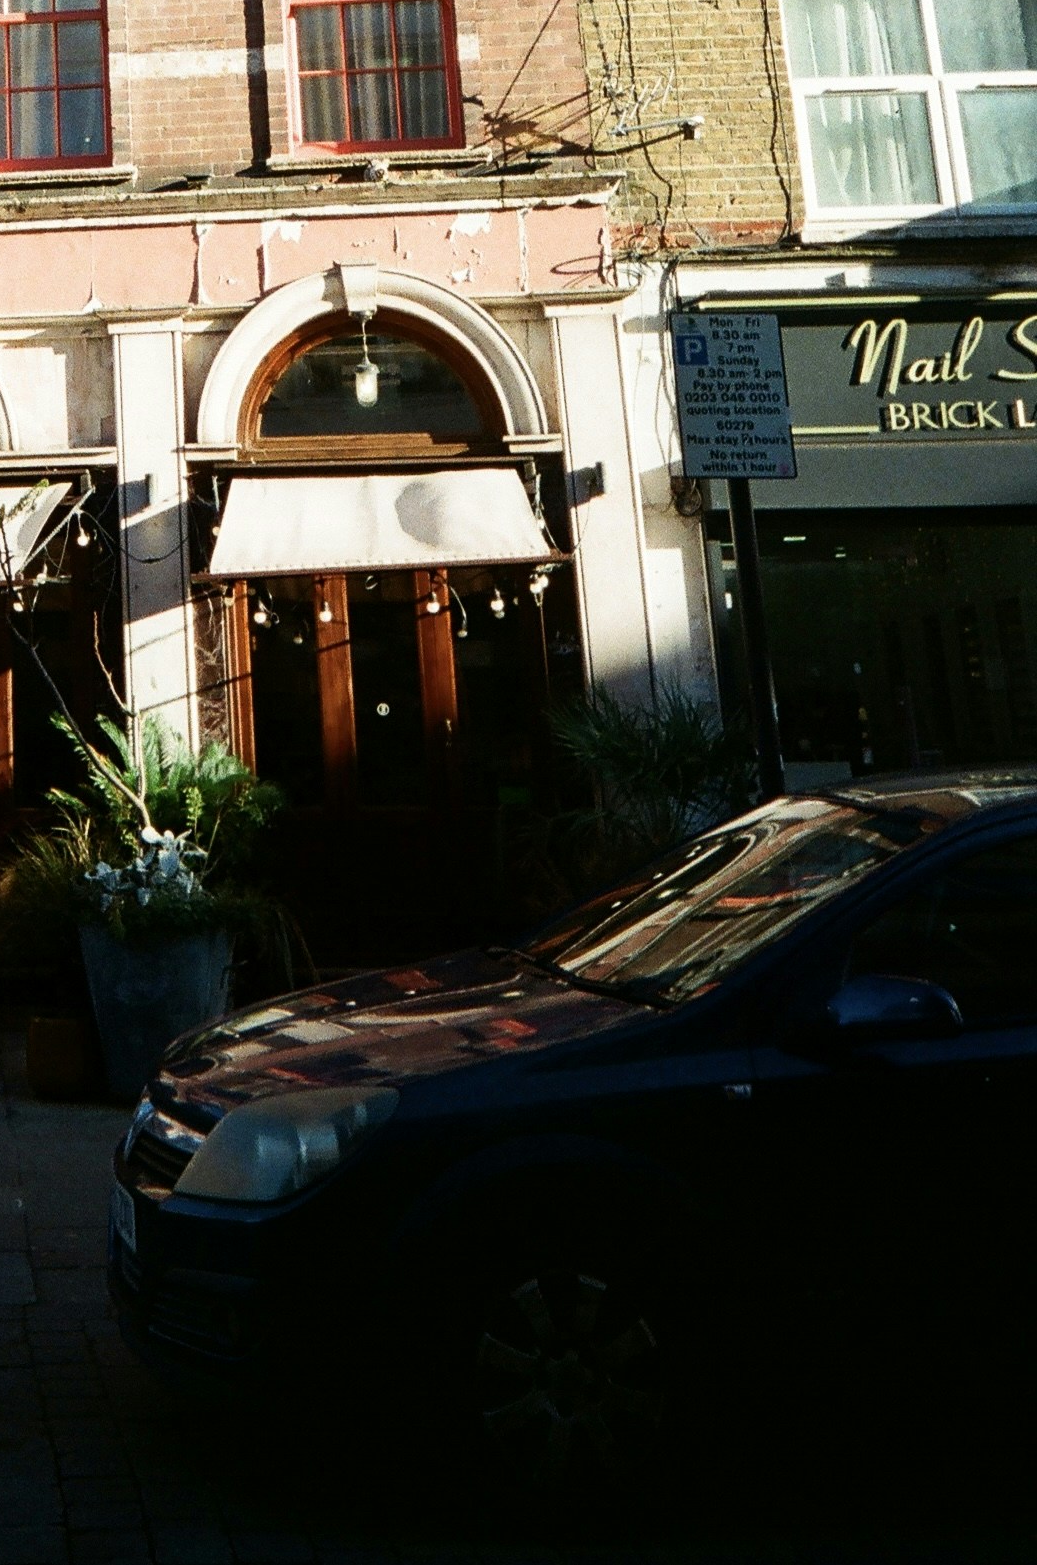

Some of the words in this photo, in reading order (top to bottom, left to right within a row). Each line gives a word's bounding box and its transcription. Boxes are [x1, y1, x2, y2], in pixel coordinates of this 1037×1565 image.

[708, 317, 734, 327] Mon
[745, 317, 760, 327] Fri
[712, 330, 740, 340] 8.30
[743, 332, 761, 340] am
[684, 338, 702, 362] P
[727, 342, 734, 352] 7
[737, 344, 756, 354] pm
[717, 356, 761, 367] Sunday
[850, 316, 984, 395] Nail
[754, 368, 761, 378] 2
[765, 370, 782, 380] pm
[693, 380, 714, 391] Pay
[717, 381, 731, 392] by
[734, 381, 770, 392] phone
[684, 392, 718, 403] 0203
[749, 392, 781, 403] 0010
[686, 406, 731, 416] quoting
[734, 403, 781, 415] location
[889, 400, 1005, 431] BRICK
[687, 434, 710, 444] Max
[714, 434, 739, 446] stay
[709, 450, 726, 460] No
[730, 450, 768, 460] return
[701, 462, 738, 472] within
[742, 462, 747, 472] 1
[750, 462, 777, 472] hour
